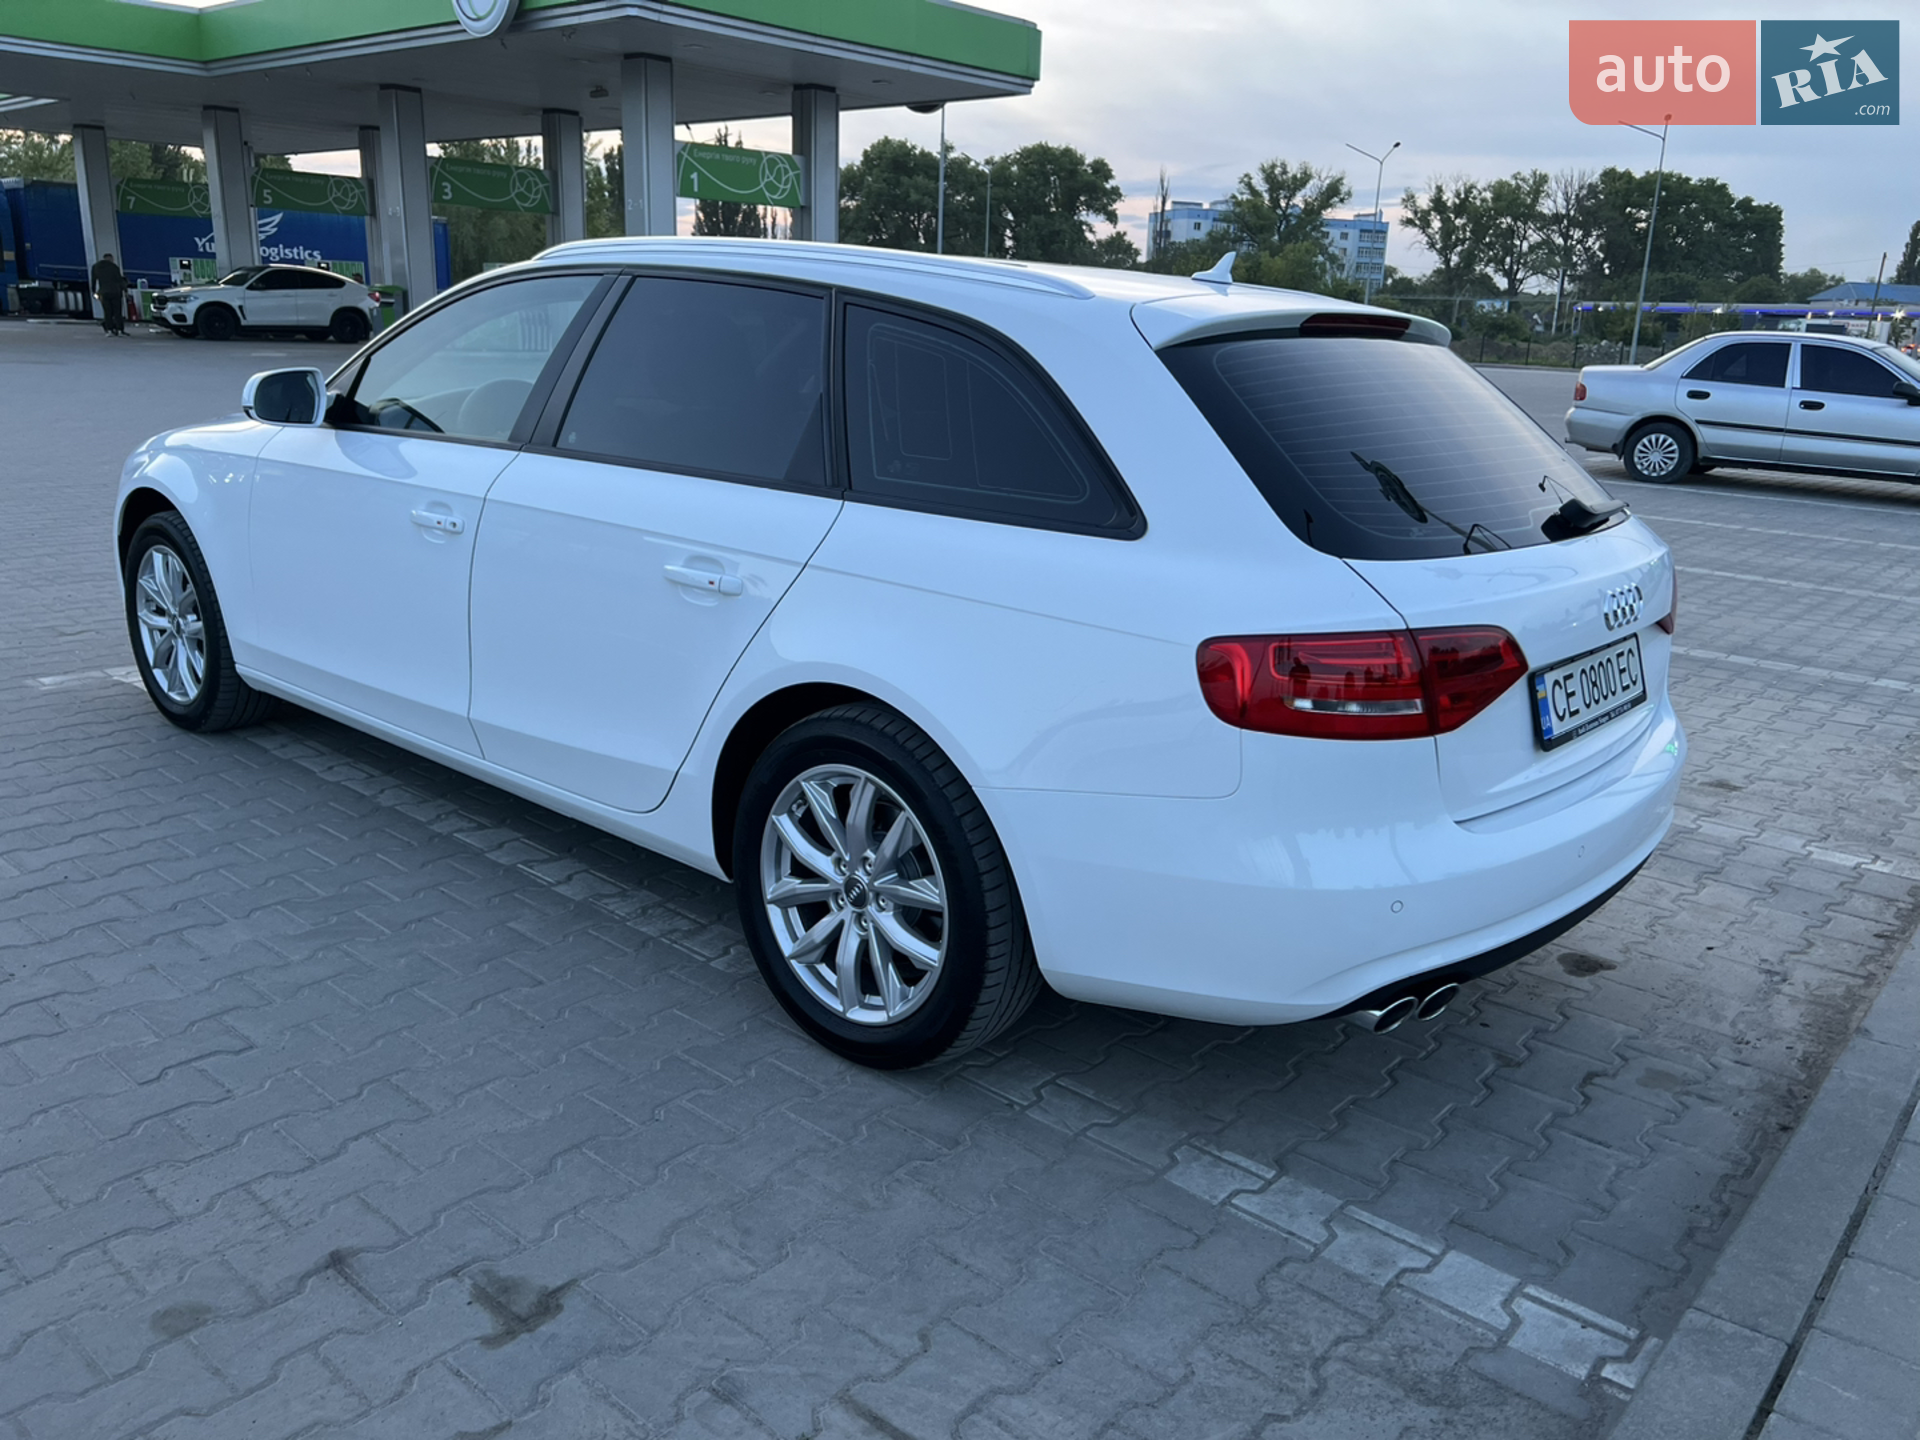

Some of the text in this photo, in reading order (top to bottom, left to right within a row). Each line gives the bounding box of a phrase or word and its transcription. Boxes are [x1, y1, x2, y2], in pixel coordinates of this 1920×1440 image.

[690, 171, 699, 192] 1
[263, 189, 273, 204] 5
[441, 182, 453, 200] 3
[126, 196, 136, 210] 7
[260, 244, 321, 261] ogistics
[1551, 672, 1580, 722] CE
[1579, 656, 1617, 709] 0800
[1616, 648, 1638, 692] EC
